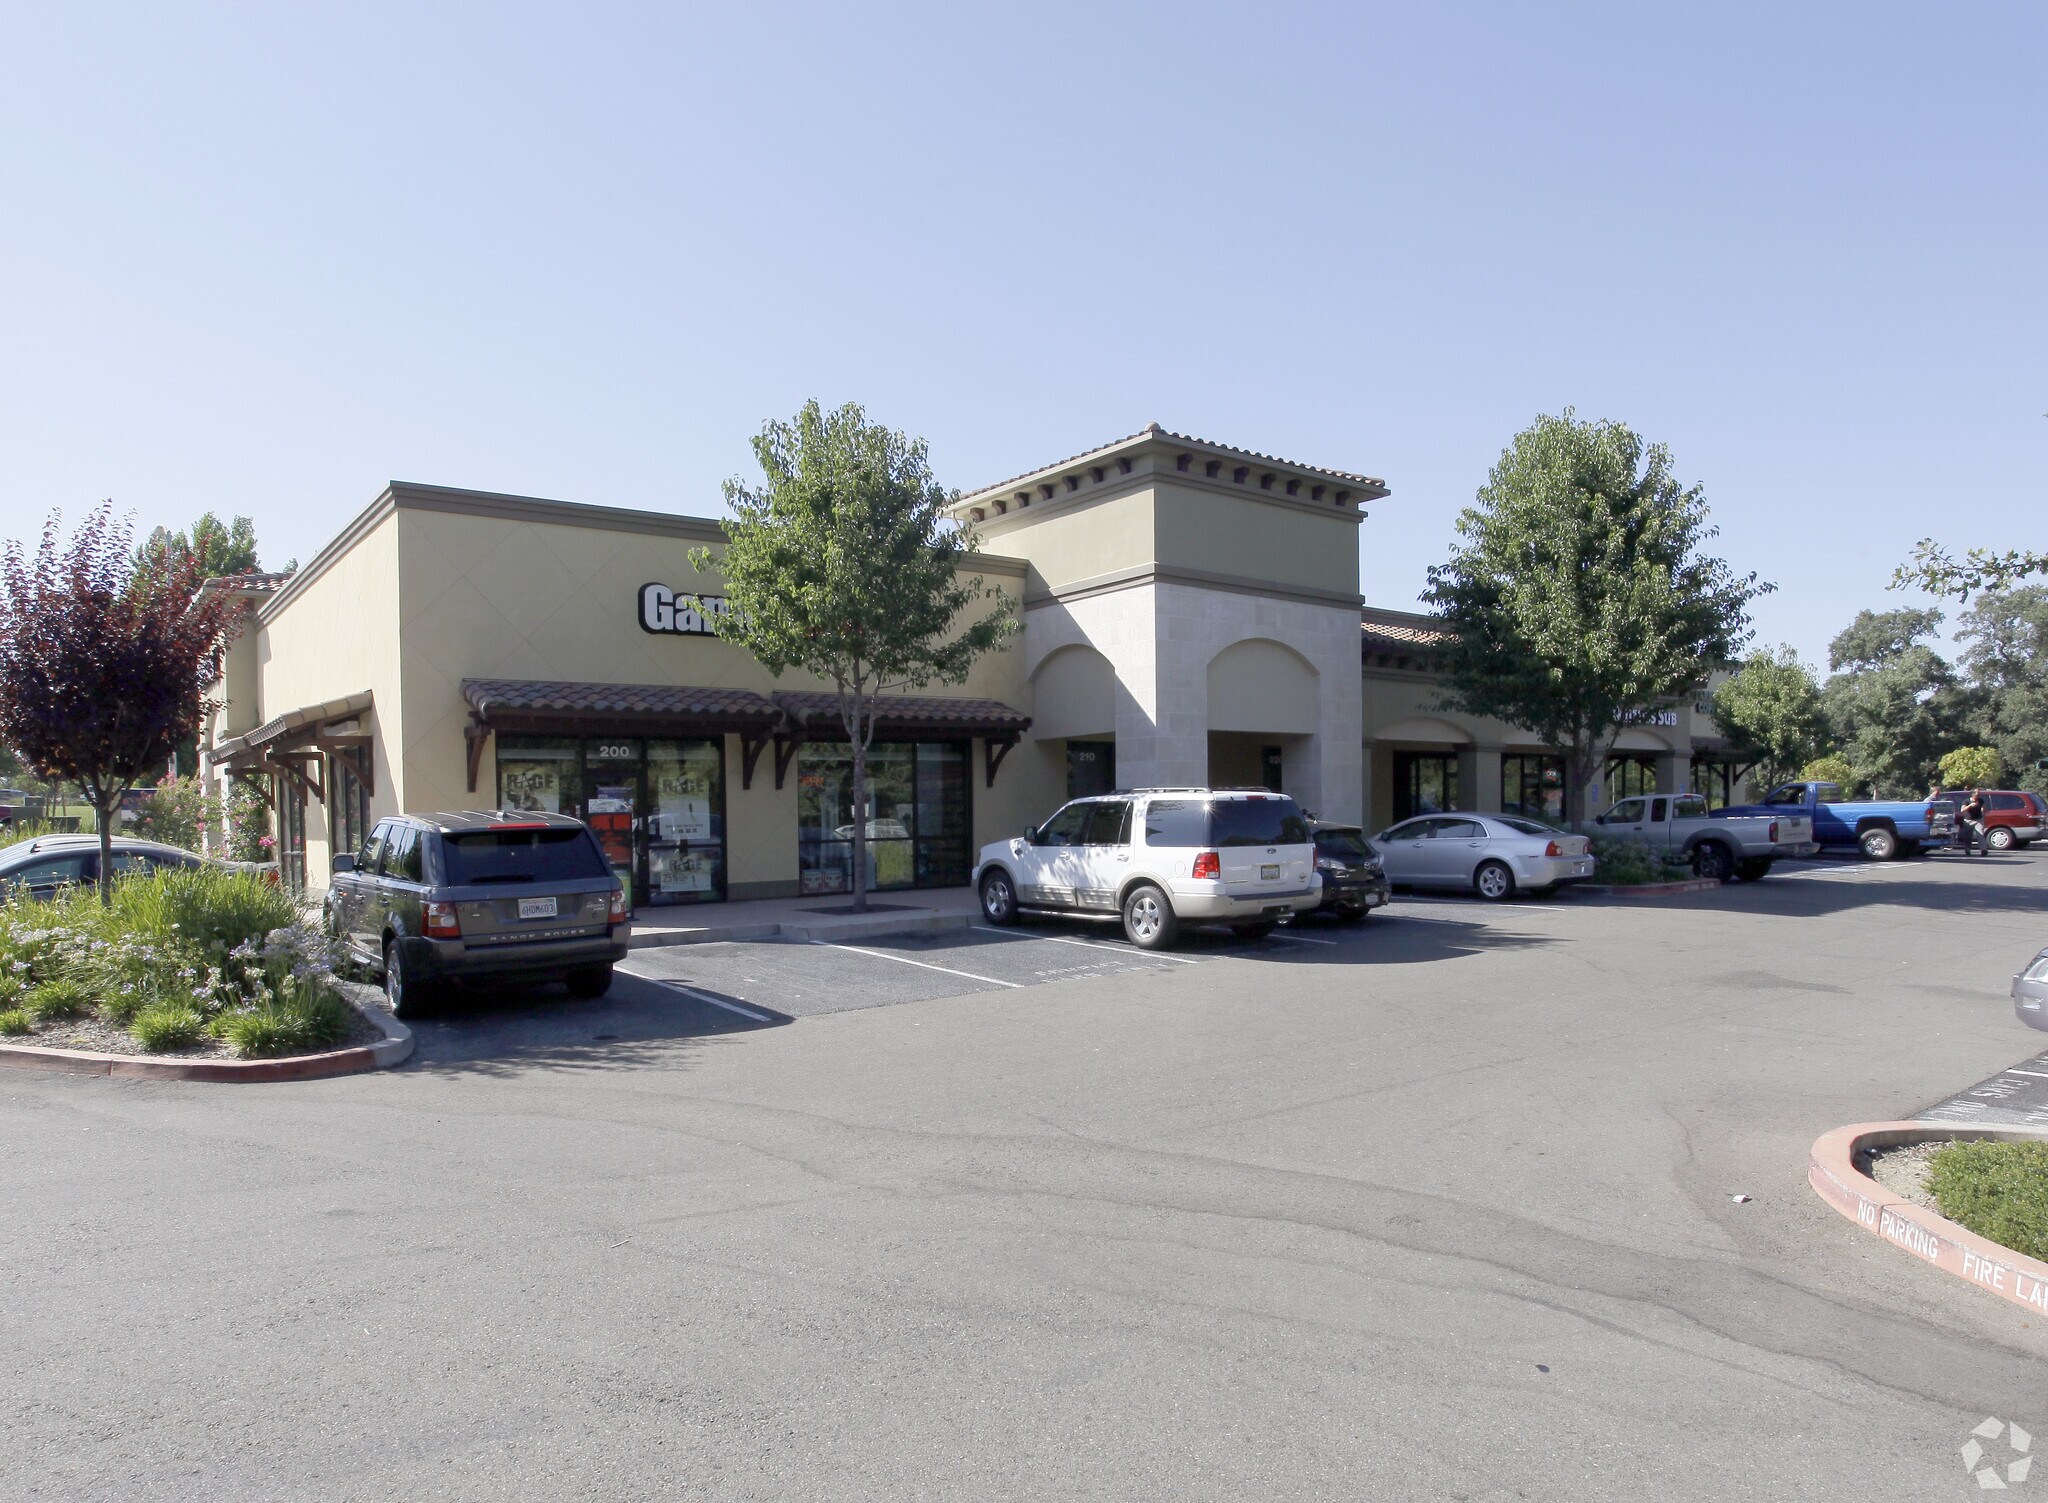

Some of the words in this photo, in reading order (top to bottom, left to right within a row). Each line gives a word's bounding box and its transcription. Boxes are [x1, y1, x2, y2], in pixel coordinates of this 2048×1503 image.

[600, 746, 630, 757] 200
[1079, 752, 1096, 761] 210
[506, 769, 553, 790] RAGE
[490, 933, 535, 941] RANGE
[1857, 1200, 1875, 1225] NO
[1879, 1211, 1939, 1259] PARKING
[1962, 1252, 2006, 1290] FIRE
